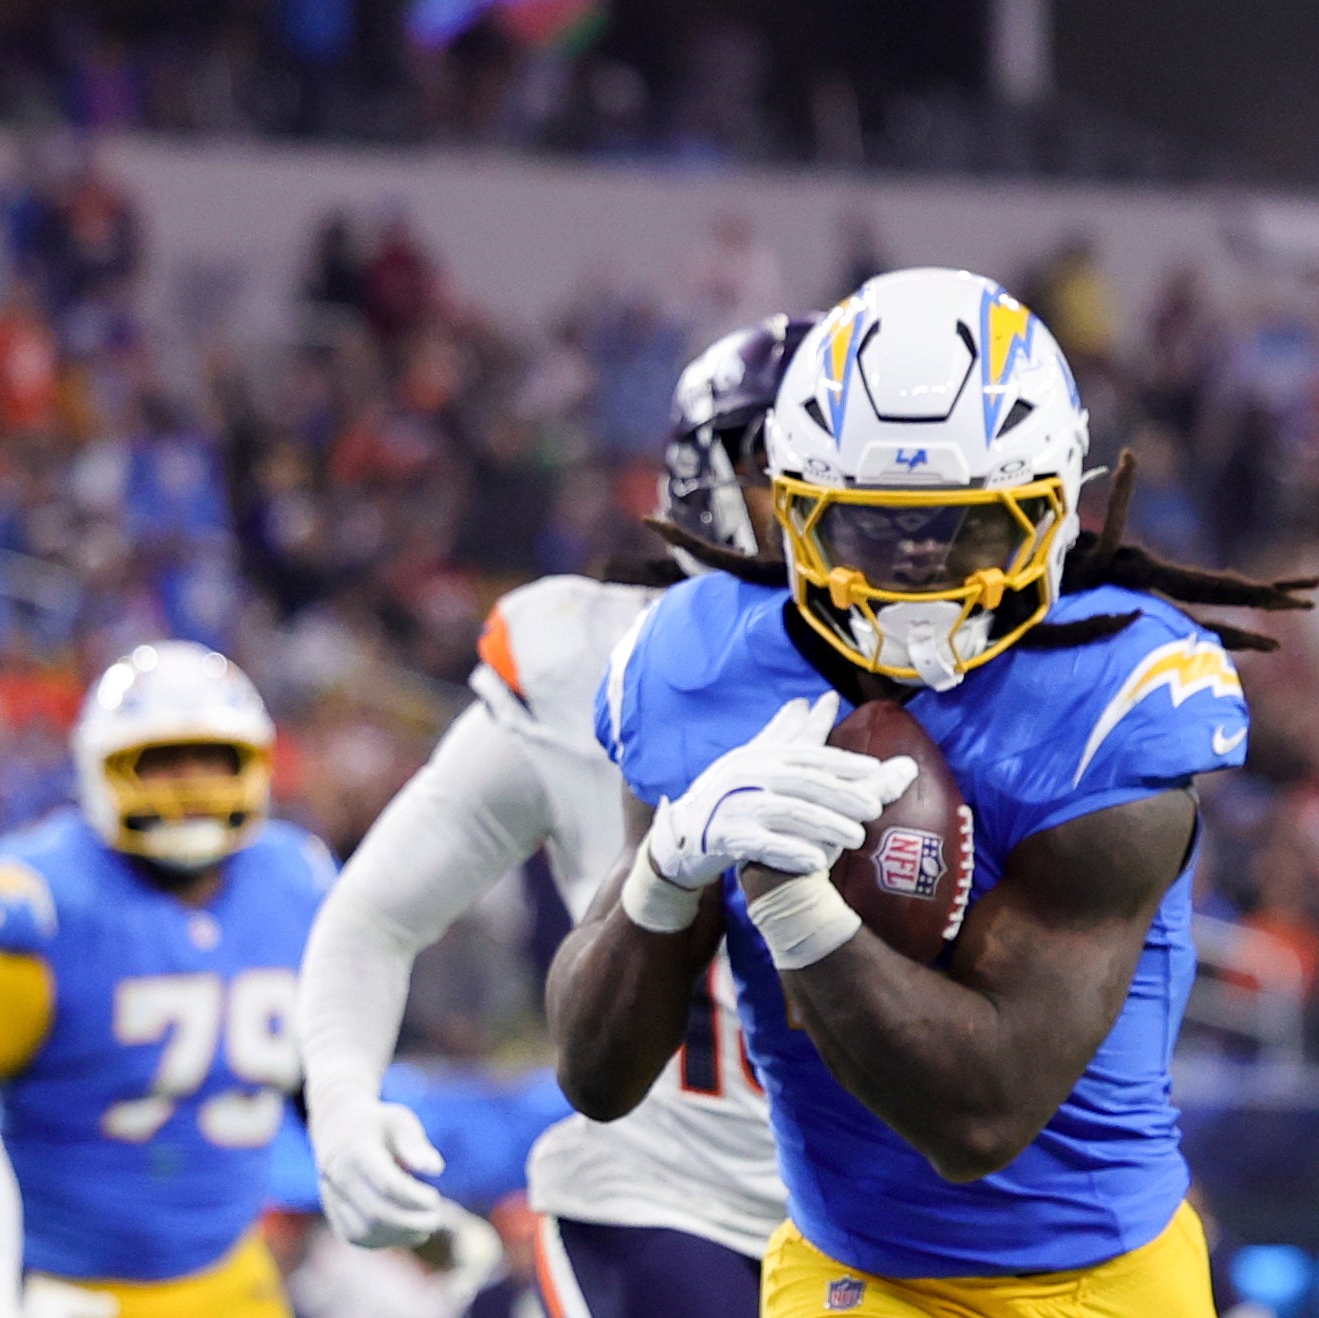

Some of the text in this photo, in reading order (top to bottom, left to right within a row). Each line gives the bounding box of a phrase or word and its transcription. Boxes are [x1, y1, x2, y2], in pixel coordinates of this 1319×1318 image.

[895, 448, 928, 473] LA
[885, 836, 919, 886] NFL
[99, 966, 304, 1148] 79
[678, 954, 766, 1097] 1
